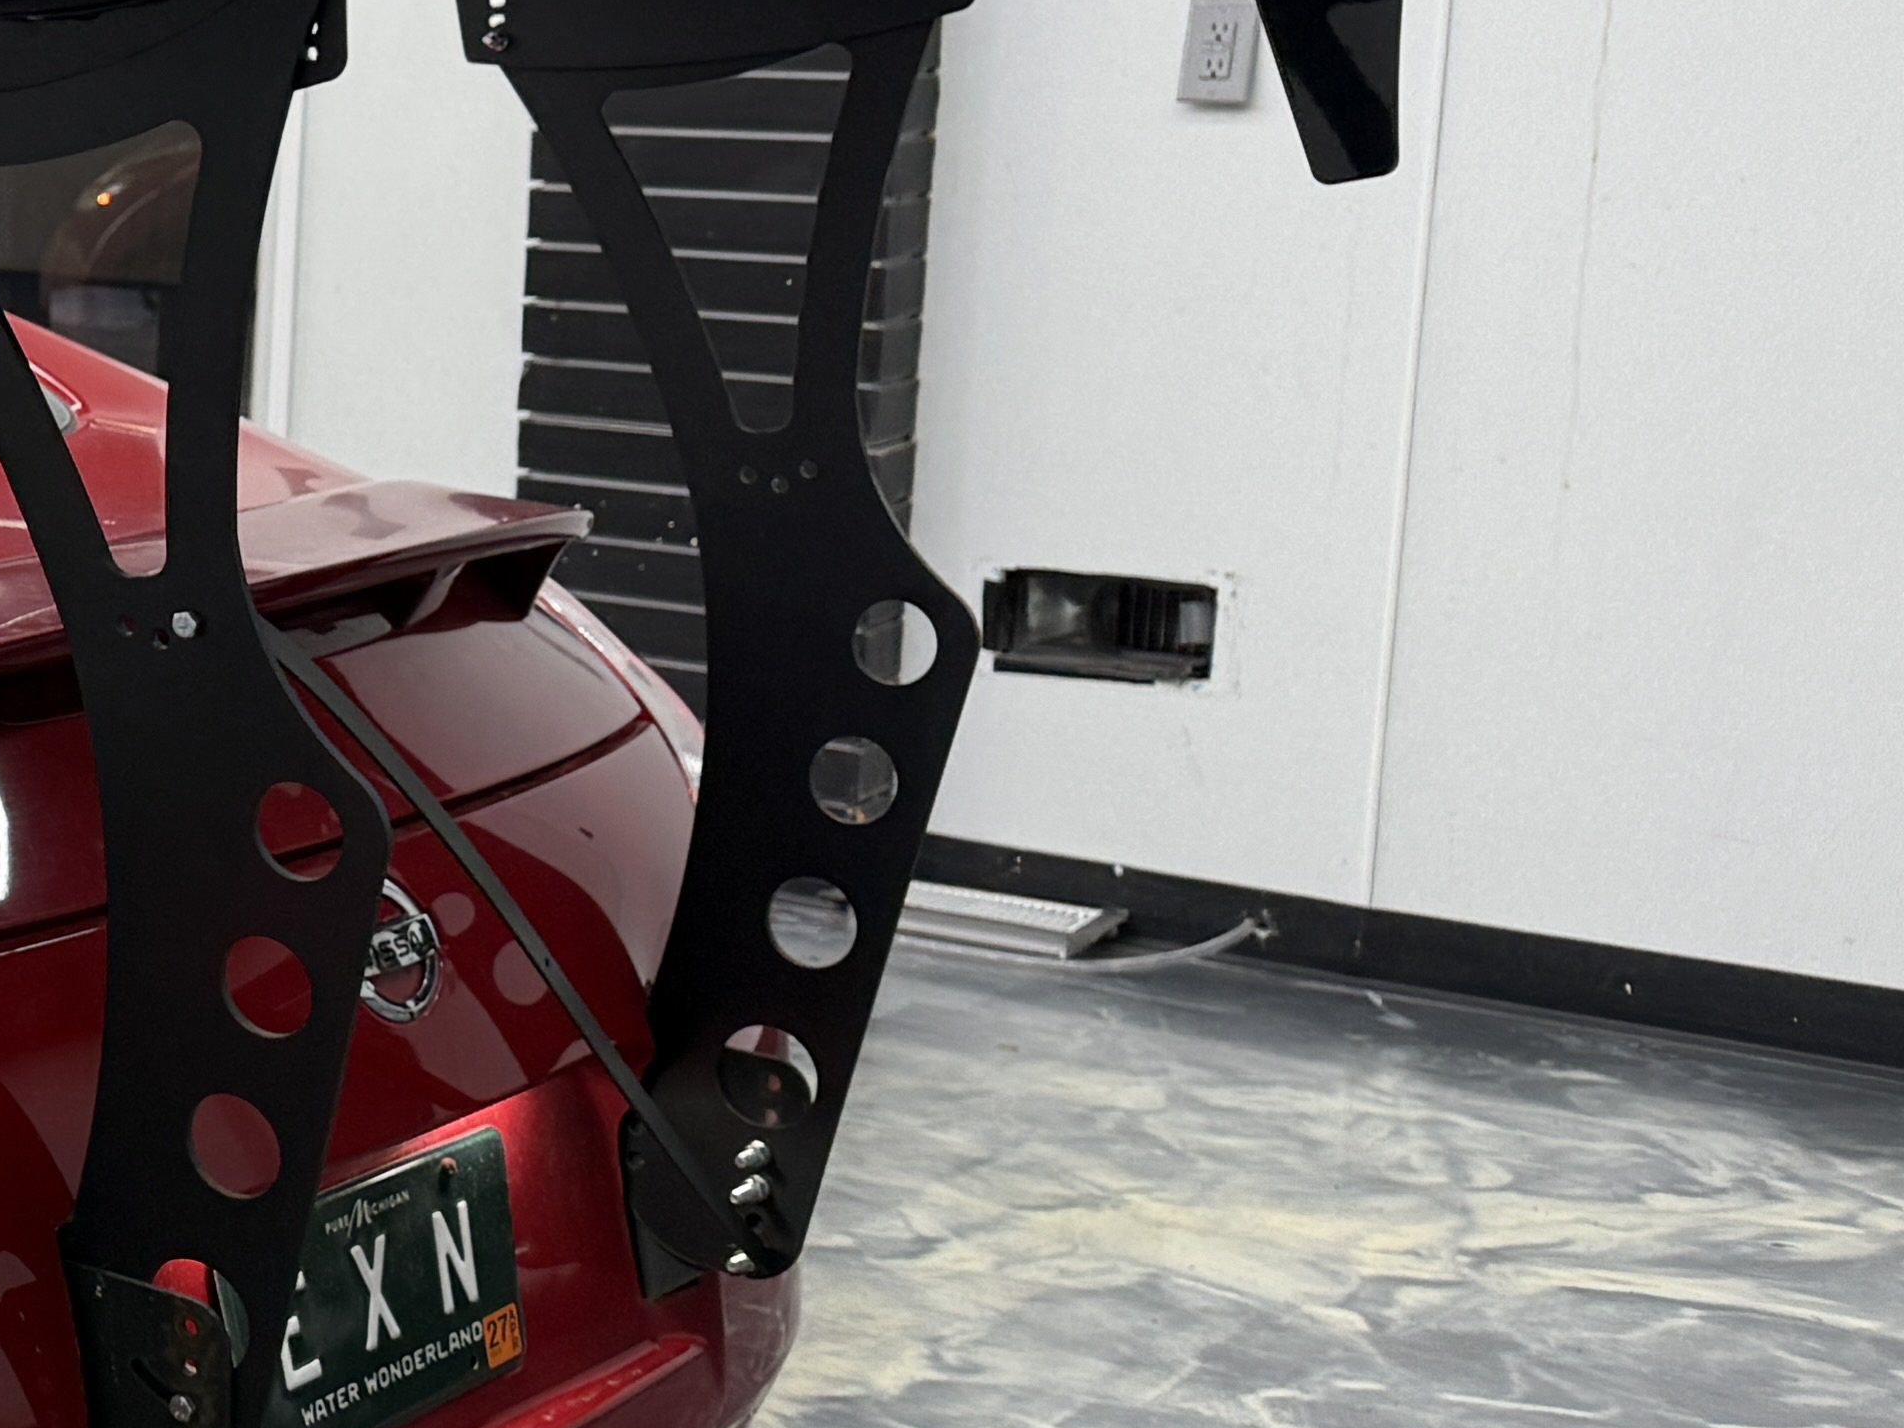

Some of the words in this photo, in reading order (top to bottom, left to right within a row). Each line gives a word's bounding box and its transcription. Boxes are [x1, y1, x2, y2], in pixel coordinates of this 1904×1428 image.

[486, 1313, 508, 1349] 27
[300, 1383, 361, 1427] WATER
[364, 1320, 484, 1395] WONDERLAND
